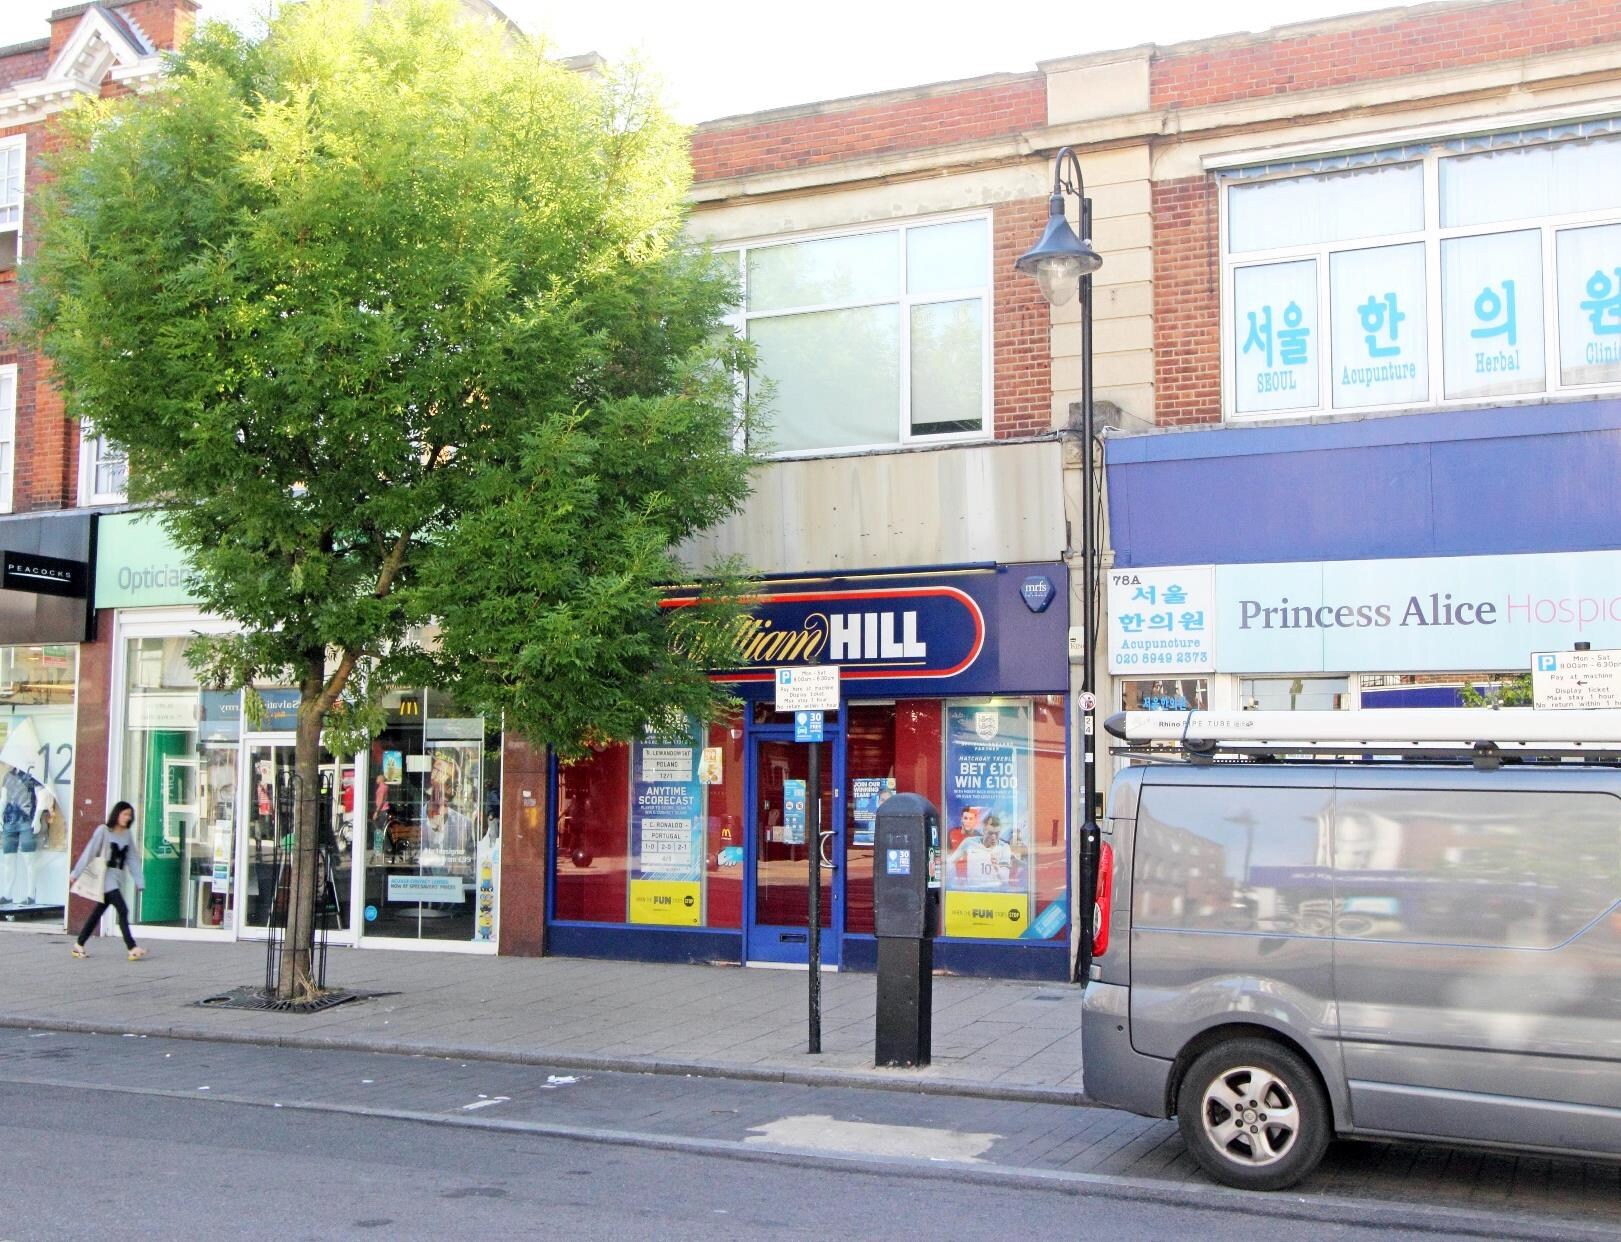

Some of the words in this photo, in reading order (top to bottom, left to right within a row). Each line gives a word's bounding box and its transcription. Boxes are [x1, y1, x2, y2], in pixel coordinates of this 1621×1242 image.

[1243, 301, 1310, 368] 서울
[1357, 292, 1405, 357] 한
[1470, 280, 1517, 346] 의
[1257, 369, 1297, 393] SEOUL
[1341, 361, 1416, 388] Acupunture
[1475, 350, 1520, 374] Herbal
[1586, 342, 1621, 365] Clini
[8, 564, 71, 578] PEACOCKS
[1025, 580, 1047, 592] mrfs
[1113, 575, 1141, 586] 78A
[1131, 584, 1188, 605] 서울
[1238, 597, 1391, 630] Princess
[1399, 593, 1497, 627] Alice
[1507, 594, 1621, 632] Hospic
[1118, 611, 1205, 632] 한의원
[667, 612, 828, 661] lliam
[830, 610, 926, 660] HILL
[1121, 637, 1200, 651] Acupuncture
[1116, 654, 1139, 664] 020
[1142, 652, 1173, 664] 8949
[1176, 651, 1208, 663] 2373
[810, 713, 822, 722] 30
[37, 743, 72, 784] 12
[961, 762, 986, 775] BET
[990, 763, 1014, 775] £10
[955, 776, 981, 788] WIN
[986, 776, 1017, 788] £100
[646, 787, 687, 795] ANYTIME
[638, 796, 694, 805] SCORECAST
[900, 850, 909, 858] 30
[981, 863, 992, 875] 10
[654, 896, 672, 905] FUN
[972, 909, 994, 919] FUN
